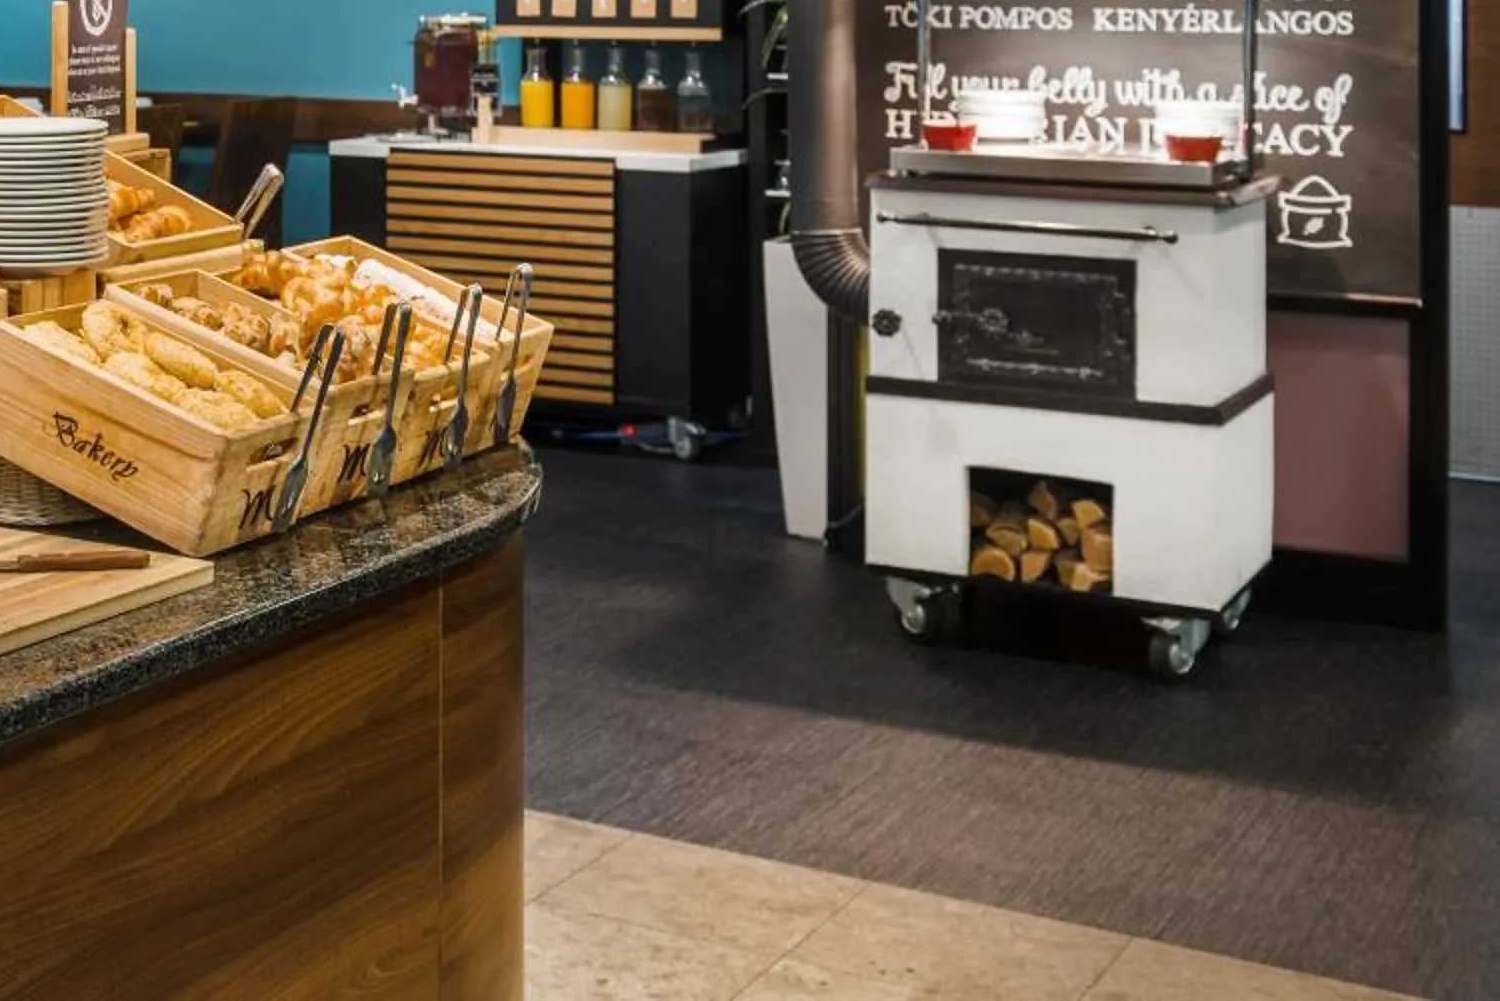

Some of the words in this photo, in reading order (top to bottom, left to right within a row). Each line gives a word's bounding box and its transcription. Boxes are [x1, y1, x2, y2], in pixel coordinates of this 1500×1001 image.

[959, 7, 1073, 32] POMPOS
[1027, 64, 1107, 118] belly
[1114, 68, 1182, 106] with
[1314, 72, 1354, 123] of
[50, 409, 140, 482] Bakery
